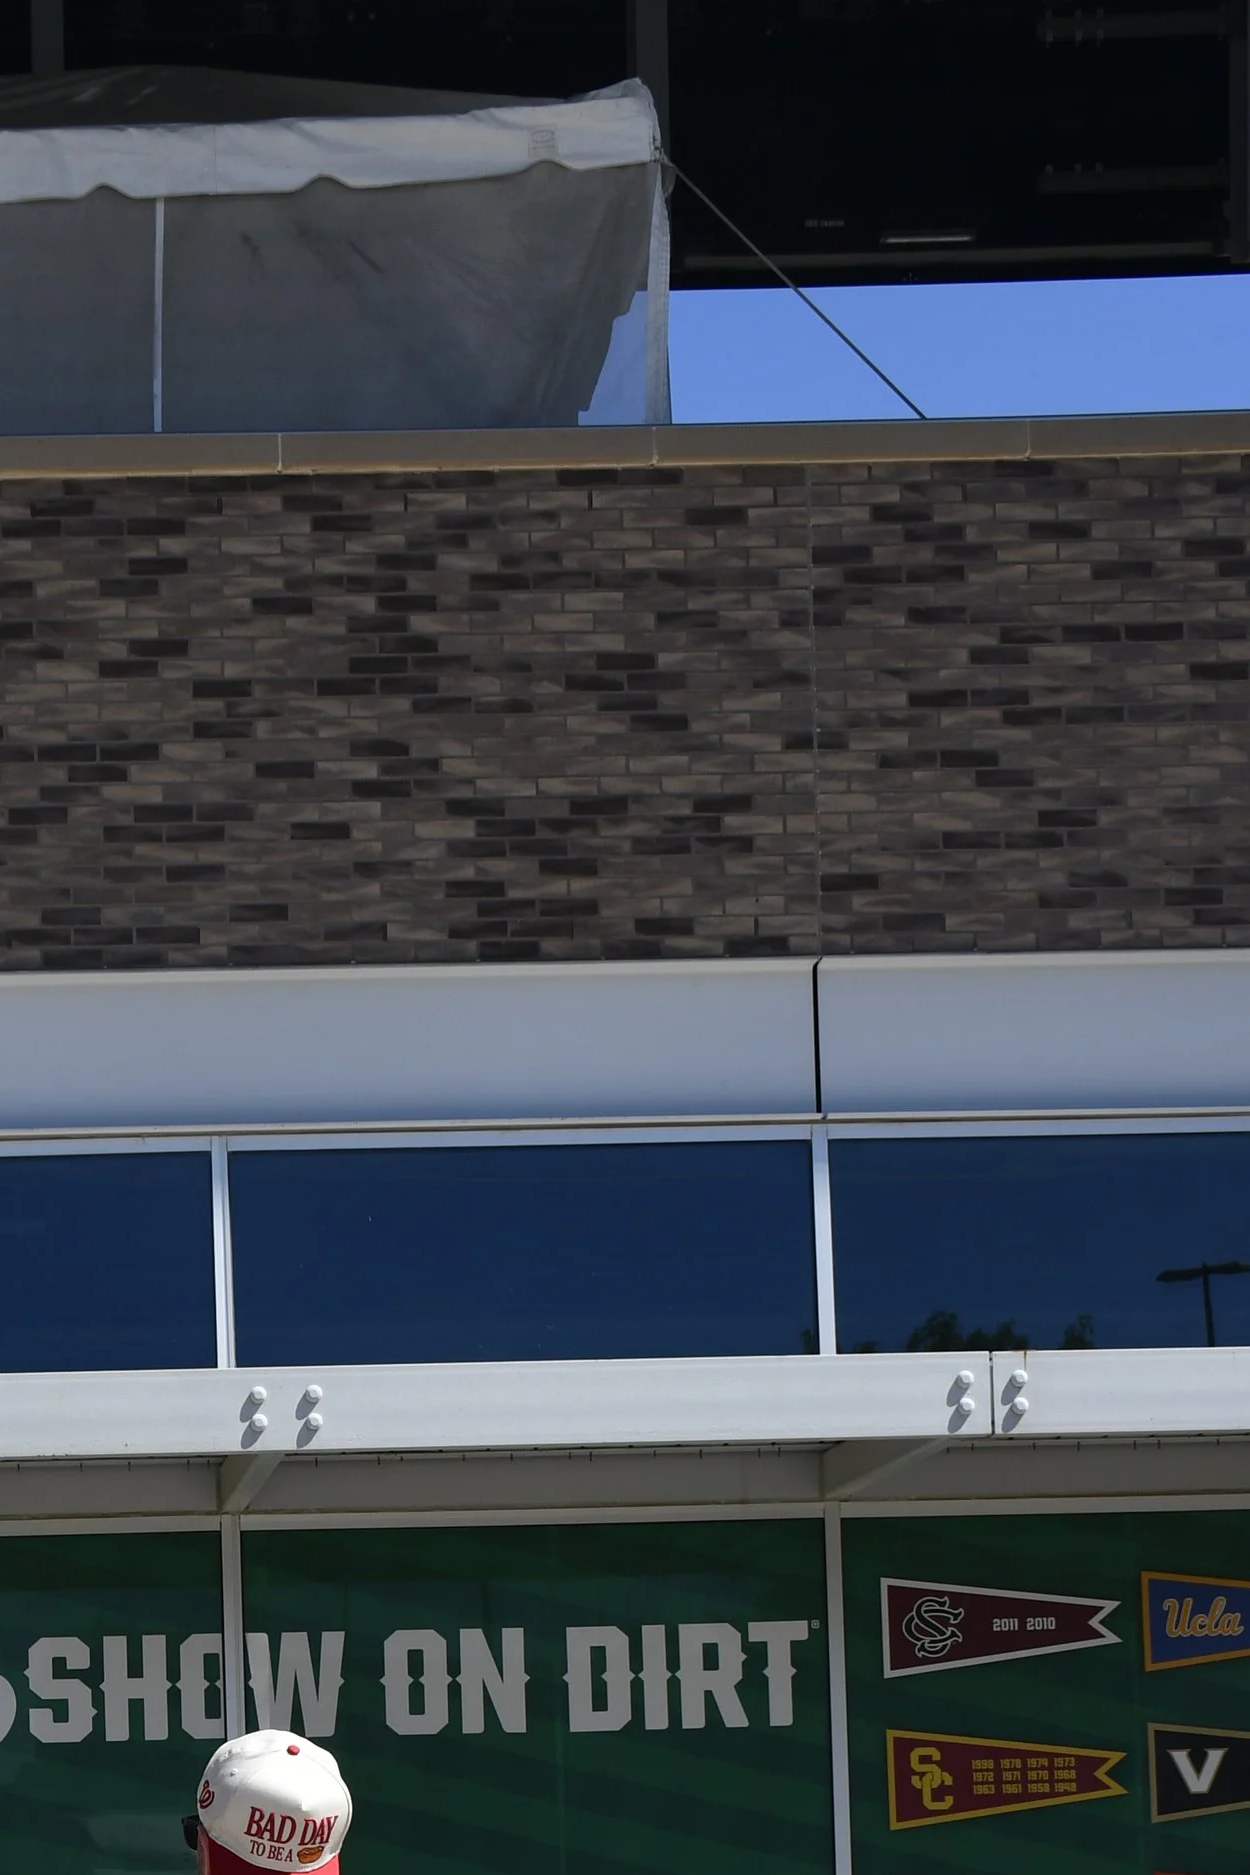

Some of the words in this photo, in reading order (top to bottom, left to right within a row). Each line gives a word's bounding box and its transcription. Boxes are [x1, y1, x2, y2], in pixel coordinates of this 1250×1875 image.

[993, 1617, 1019, 1632] 2011
[1026, 1616, 1056, 1631] 2010
[1163, 1596, 1245, 1638] Ucla
[23, 1630, 346, 1744] SHOW
[379, 1626, 531, 1736] ON
[563, 1619, 810, 1735] DIRT
[971, 1759, 994, 1770] 1998
[1000, 1758, 1022, 1769] 1978
[1027, 1757, 1049, 1768] 1974
[1054, 1757, 1076, 1767] 1973
[972, 1771, 995, 1782] 1972
[1002, 1771, 1021, 1781] 1971
[1027, 1770, 1049, 1780] 1970
[1054, 1769, 1077, 1780] 1968
[1166, 1747, 1230, 1794] V
[973, 1784, 995, 1795] 1963
[1002, 1783, 1022, 1794] 1961
[1027, 1783, 1050, 1793] 1958
[1054, 1782, 1077, 1793] 1948
[244, 1806, 297, 1845] BAD
[298, 1815, 339, 1846] DAY
[250, 1839, 265, 1856] TO
[268, 1846, 283, 1862] BE
[284, 1848, 293, 1863] A
